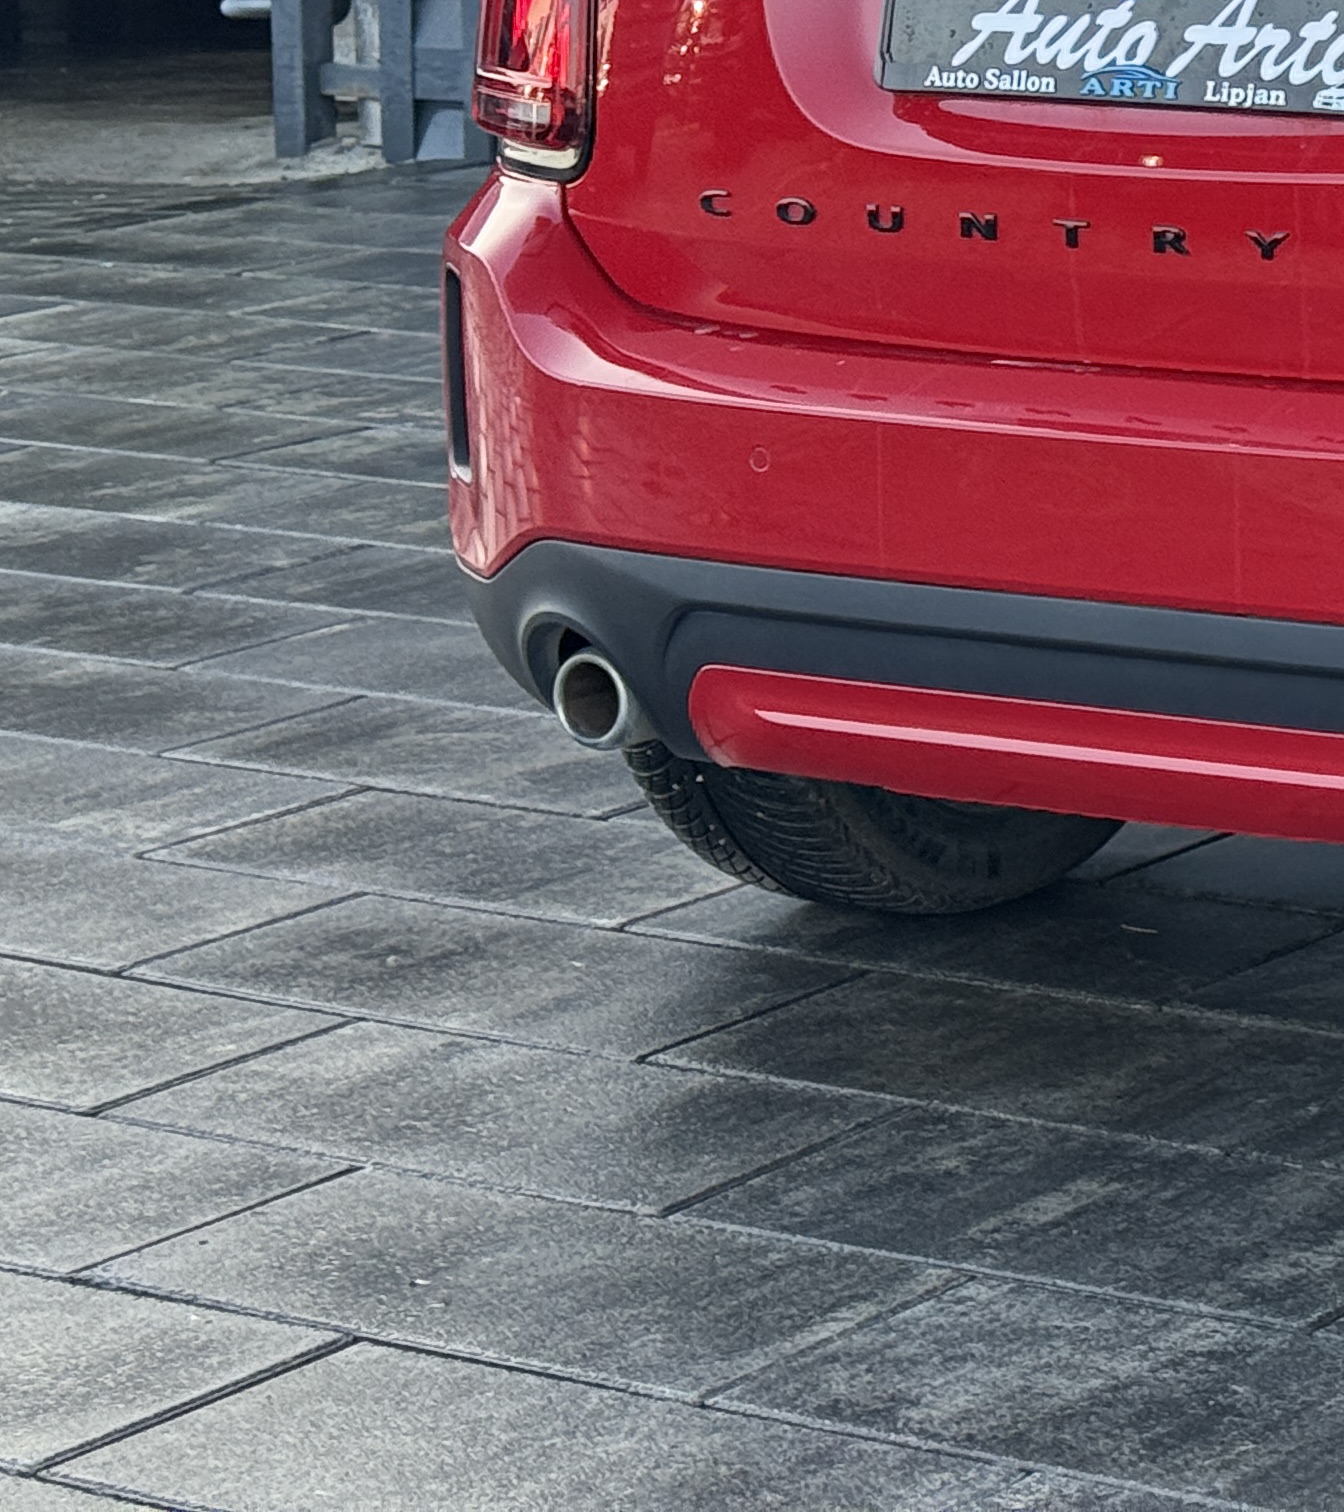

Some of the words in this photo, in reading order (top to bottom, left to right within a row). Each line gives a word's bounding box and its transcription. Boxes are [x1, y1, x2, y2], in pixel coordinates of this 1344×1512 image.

[924, 65, 979, 89] Auto
[984, 67, 1056, 94] Sallon
[1079, 76, 1180, 101] ARTI
[1203, 80, 1288, 108] Lipjan
